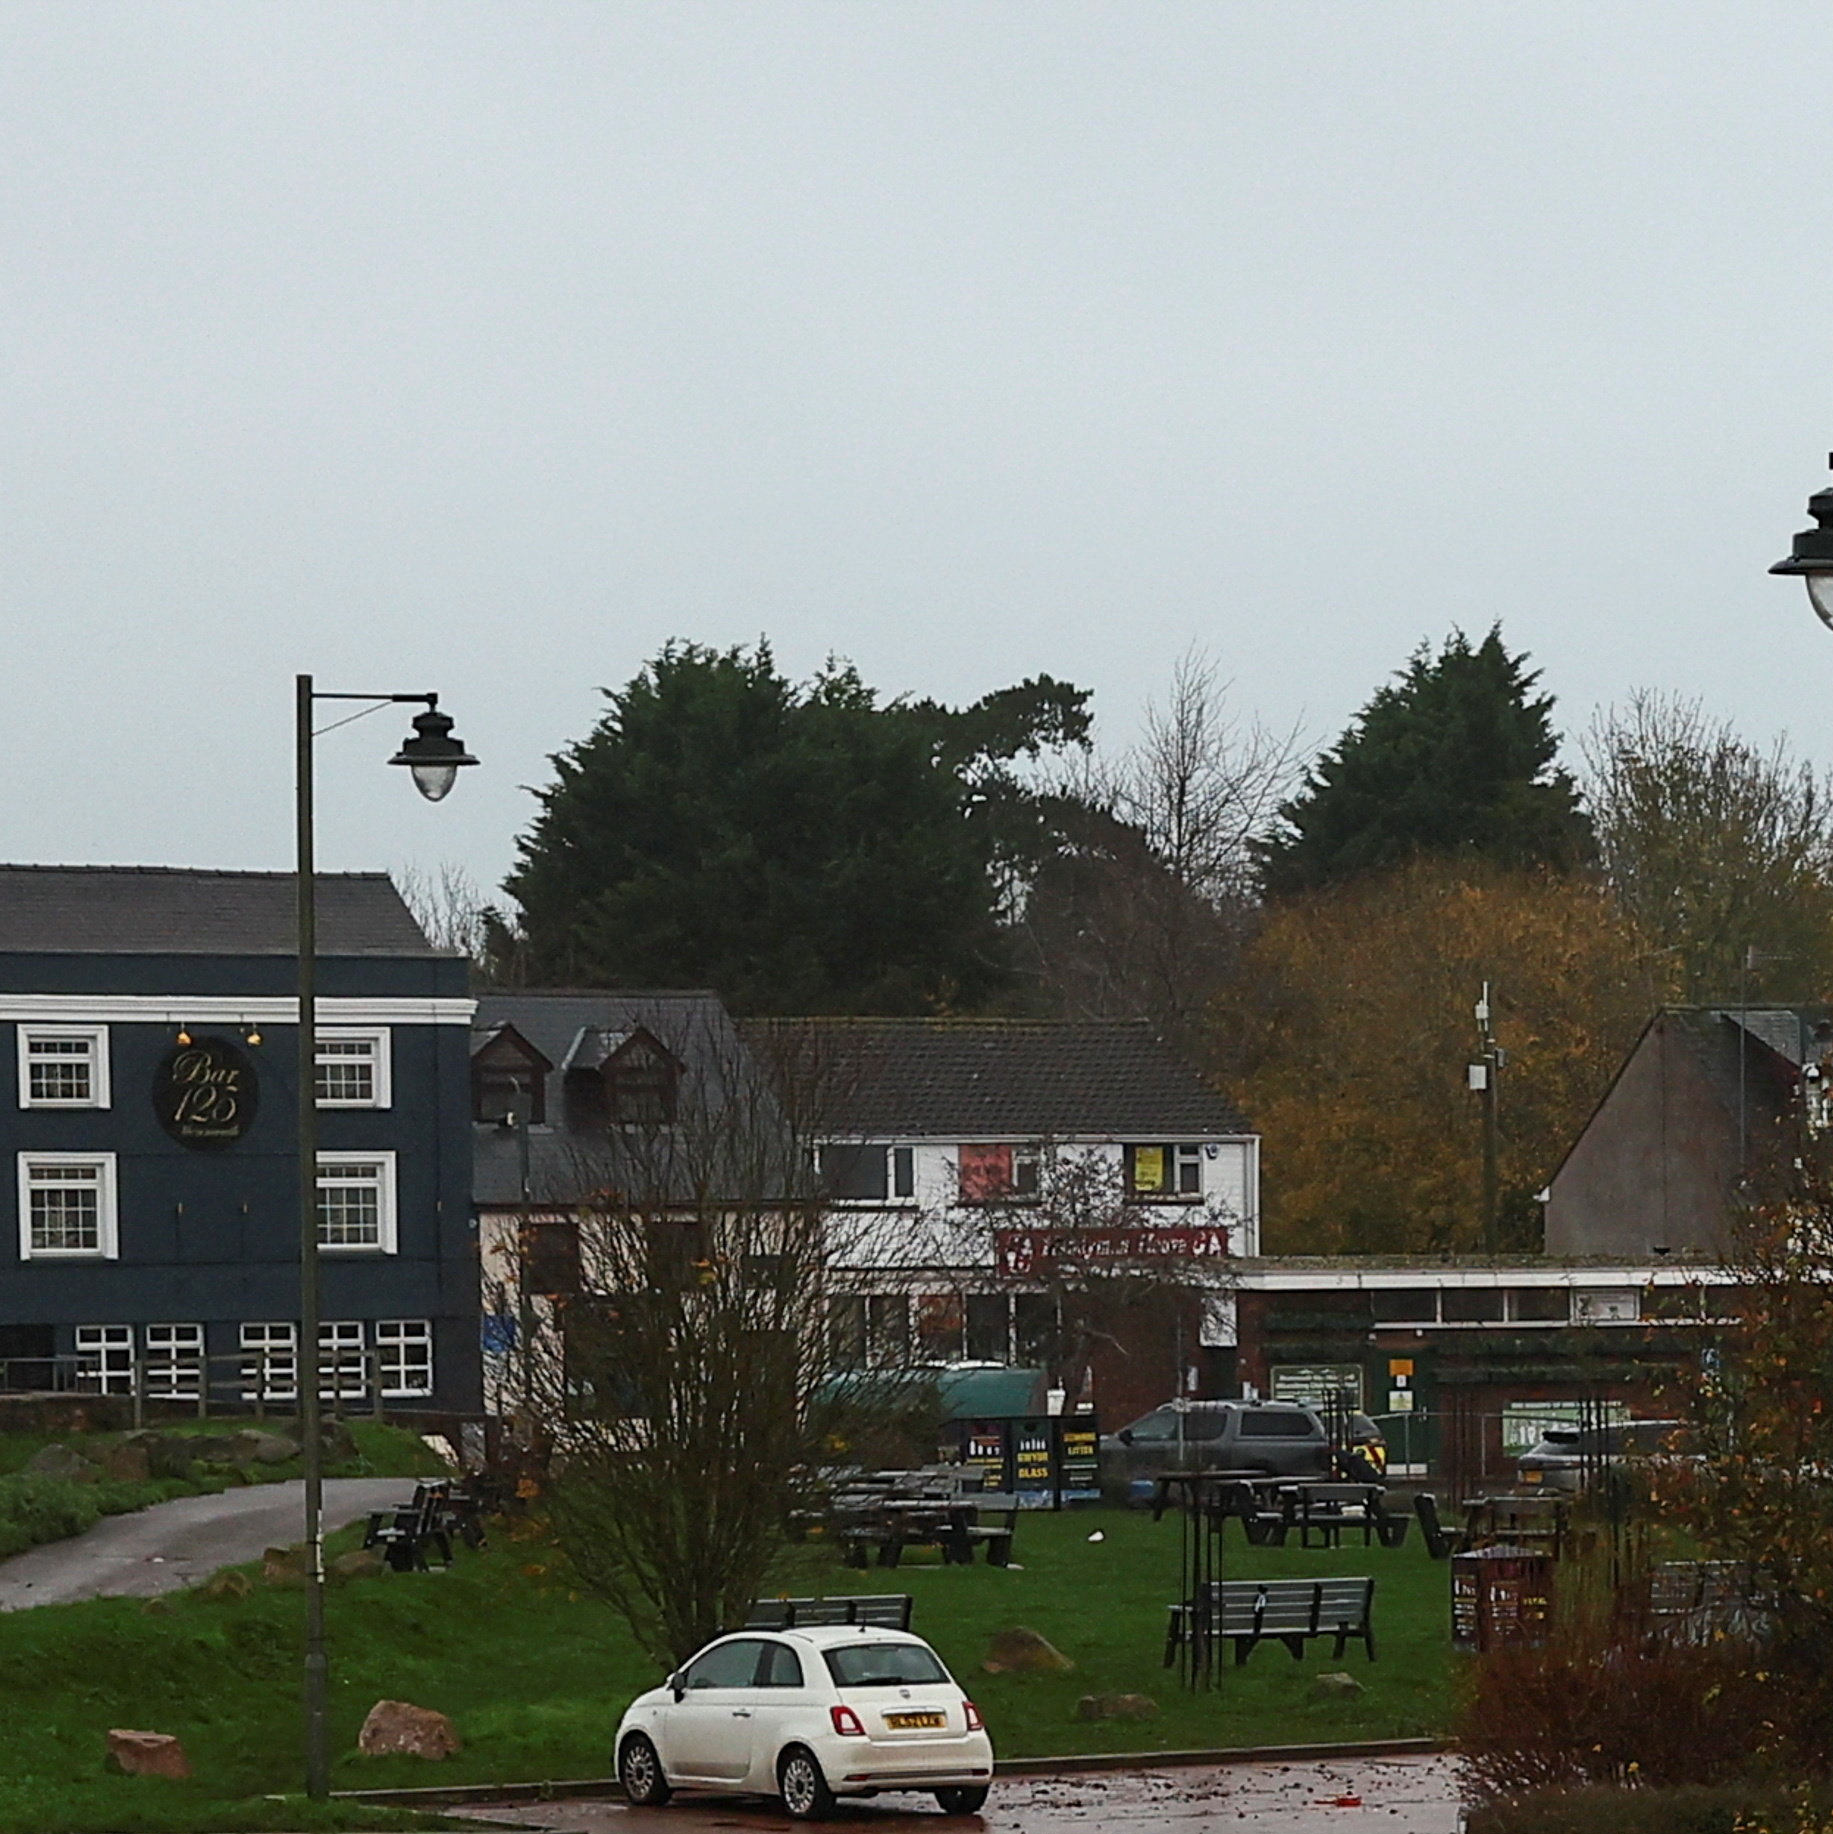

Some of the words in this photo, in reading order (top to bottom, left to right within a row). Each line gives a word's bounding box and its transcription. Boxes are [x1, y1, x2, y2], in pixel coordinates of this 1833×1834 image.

[173, 1050, 240, 1084] Bar
[174, 1085, 238, 1122] 125
[1018, 1467, 1048, 1479] GLASS
